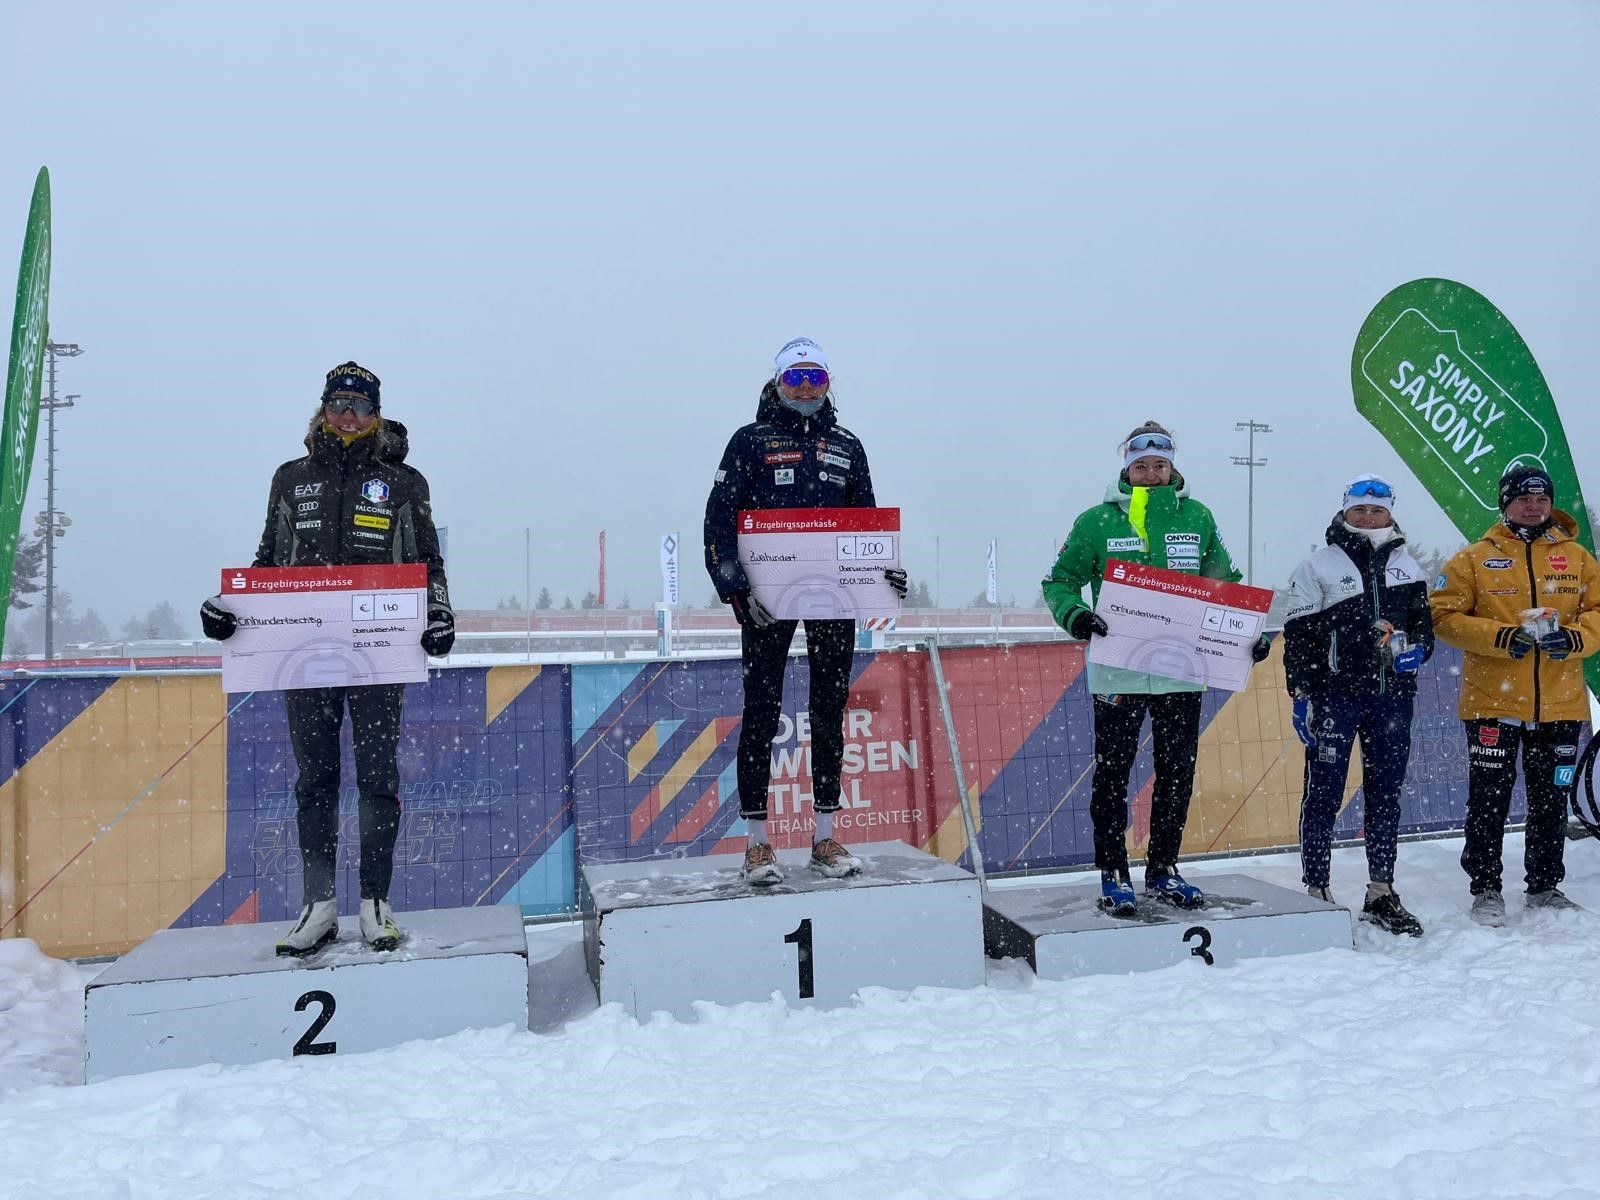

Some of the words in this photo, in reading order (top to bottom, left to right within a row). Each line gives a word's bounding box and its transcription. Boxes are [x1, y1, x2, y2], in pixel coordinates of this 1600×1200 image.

[1427, 353, 1506, 429] SIMPLY
[1389, 360, 1495, 475] SAXONY.
[295, 483, 323, 496] EA7
[756, 520, 837, 530] Erzgebirgssparkasse
[860, 542, 884, 556] 200
[251, 578, 353, 590] Erzgebirgssparkasse
[1128, 574, 1212, 598] Erzgebirgssparkasse
[383, 603, 399, 612] 160
[1229, 618, 1244, 630] 140
[770, 740, 919, 779] WISEN
[856, 809, 923, 826] CENTER
[1182, 926, 1214, 966] 3
[784, 918, 815, 999] 1
[292, 990, 337, 1056] 2
